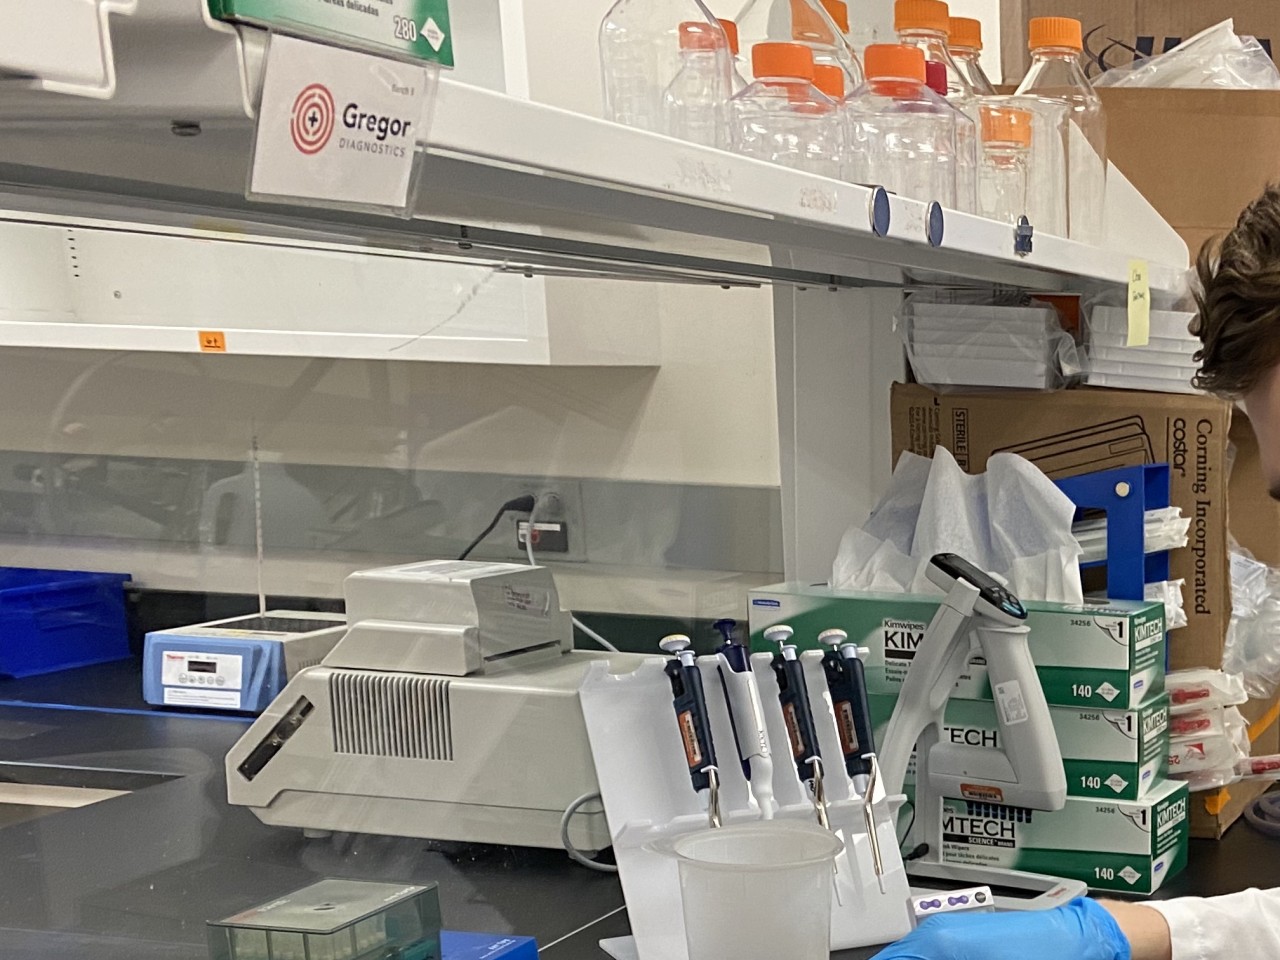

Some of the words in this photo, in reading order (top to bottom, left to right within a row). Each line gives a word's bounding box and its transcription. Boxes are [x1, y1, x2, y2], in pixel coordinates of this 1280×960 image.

[393, 15, 417, 42] 280
[343, 103, 411, 141] Gregor
[338, 137, 406, 159] DIAGNOSTICS
[955, 410, 967, 453] STERILE
[1192, 418, 1213, 494] Corning
[1192, 497, 1212, 615] Incorporated
[884, 620, 924, 631] Kimwipes
[1070, 619, 1091, 627] 34256
[1117, 621, 1124, 638] 1
[1134, 617, 1163, 643] KIMTECH
[1071, 684, 1092, 698] 140
[1079, 713, 1100, 721] 34256
[1125, 715, 1132, 732] 1
[1142, 709, 1168, 733] KIMTECH
[1080, 776, 1100, 790] 140
[1095, 806, 1116, 814] 34256
[1140, 809, 1147, 826] 1
[1156, 797, 1186, 828] KIMTECH
[1094, 867, 1114, 881] 140
